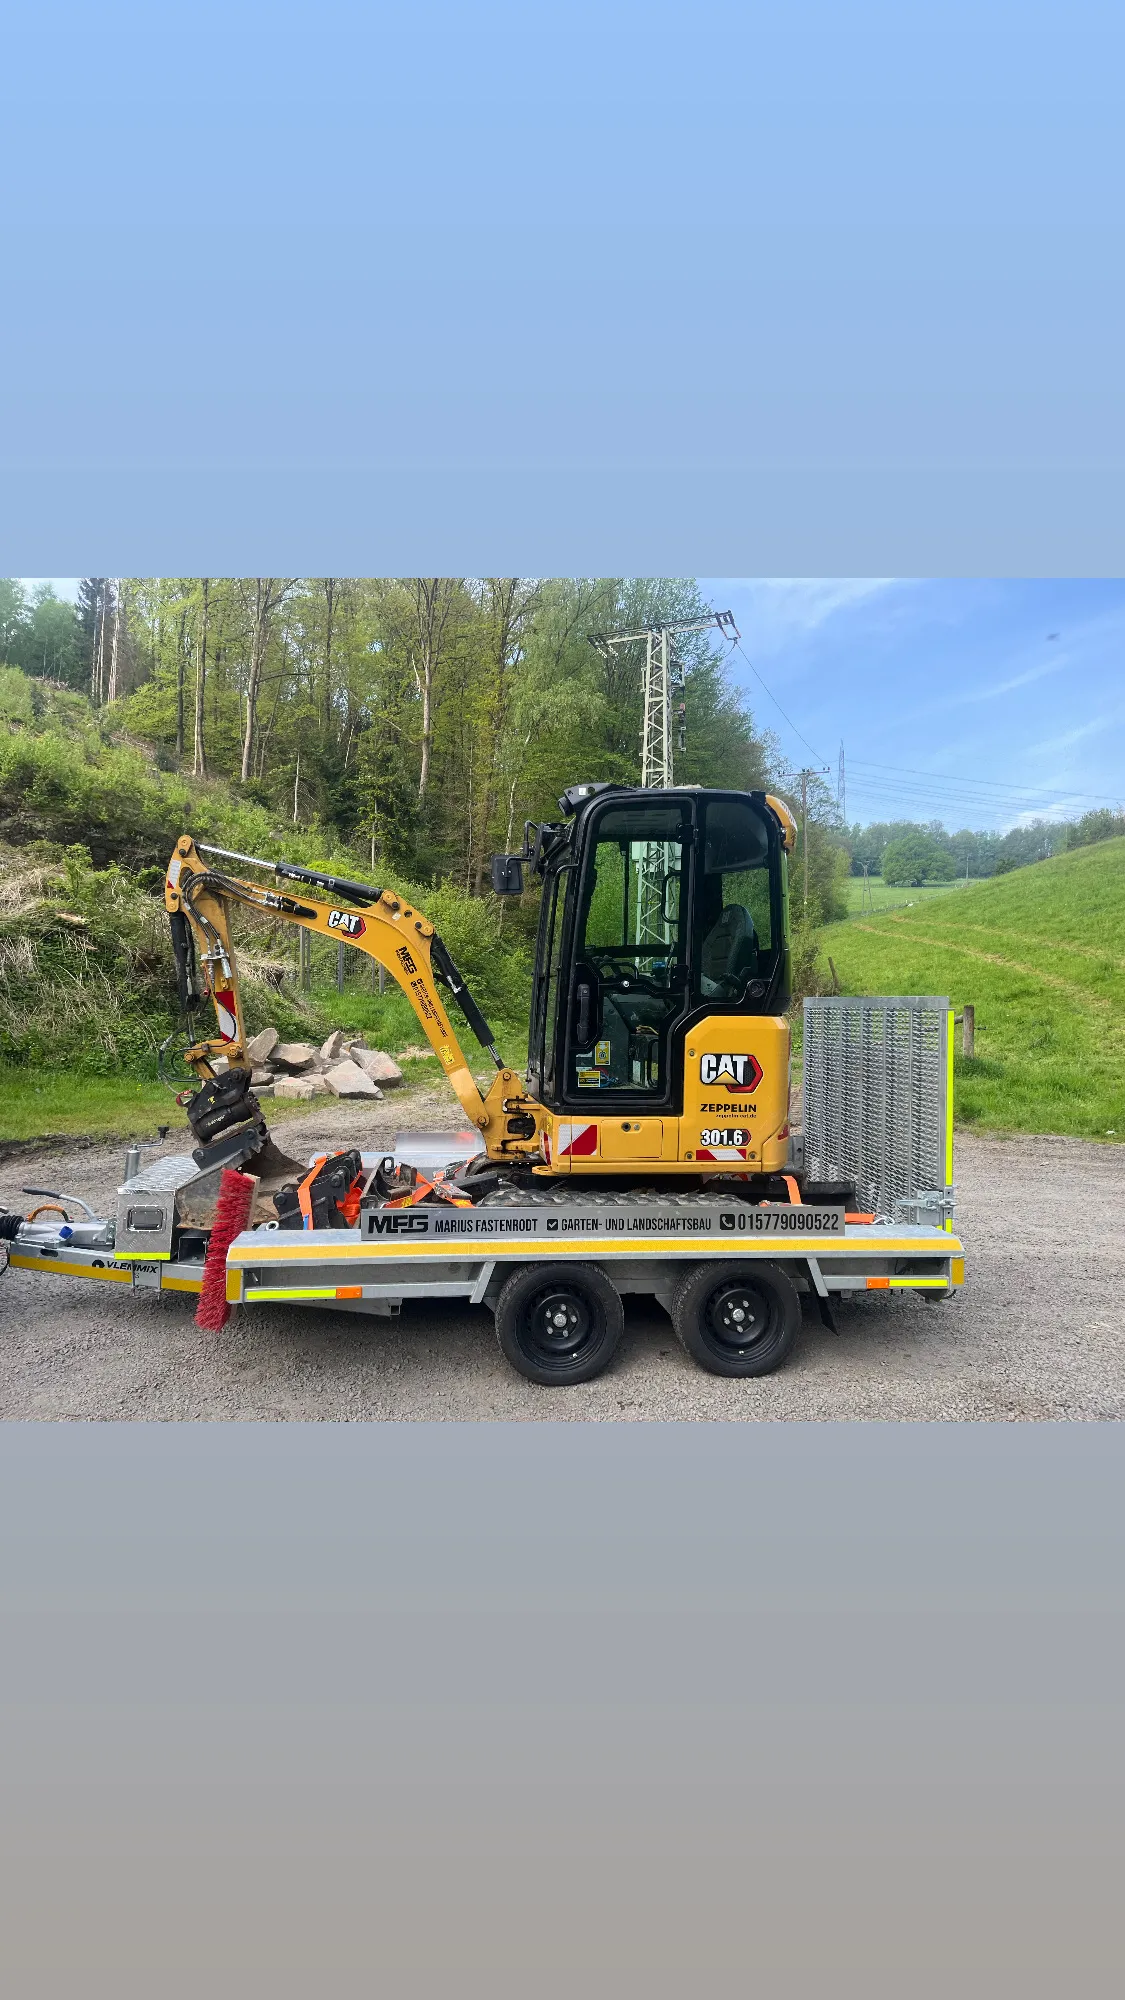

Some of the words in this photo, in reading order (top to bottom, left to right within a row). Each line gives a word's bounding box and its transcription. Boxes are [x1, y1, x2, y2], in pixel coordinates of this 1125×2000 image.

[328, 910, 359, 932] CAT
[398, 946, 417, 974] MFG
[701, 1054, 748, 1085] CAT
[700, 1104, 757, 1112] ZEPPELIN
[701, 1129, 743, 1146] 301.6
[368, 1215, 429, 1234] MFG
[435, 1220, 473, 1233] MARIUS
[475, 1219, 538, 1232] FASTENRODT
[561, 1218, 603, 1231] GARTEN-
[605, 1218, 625, 1231] UND
[626, 1217, 712, 1230] LANDSCHAFTSBAU
[738, 1213, 840, 1230] 015779090522
[107, 1261, 158, 1274] VLEMMIX
